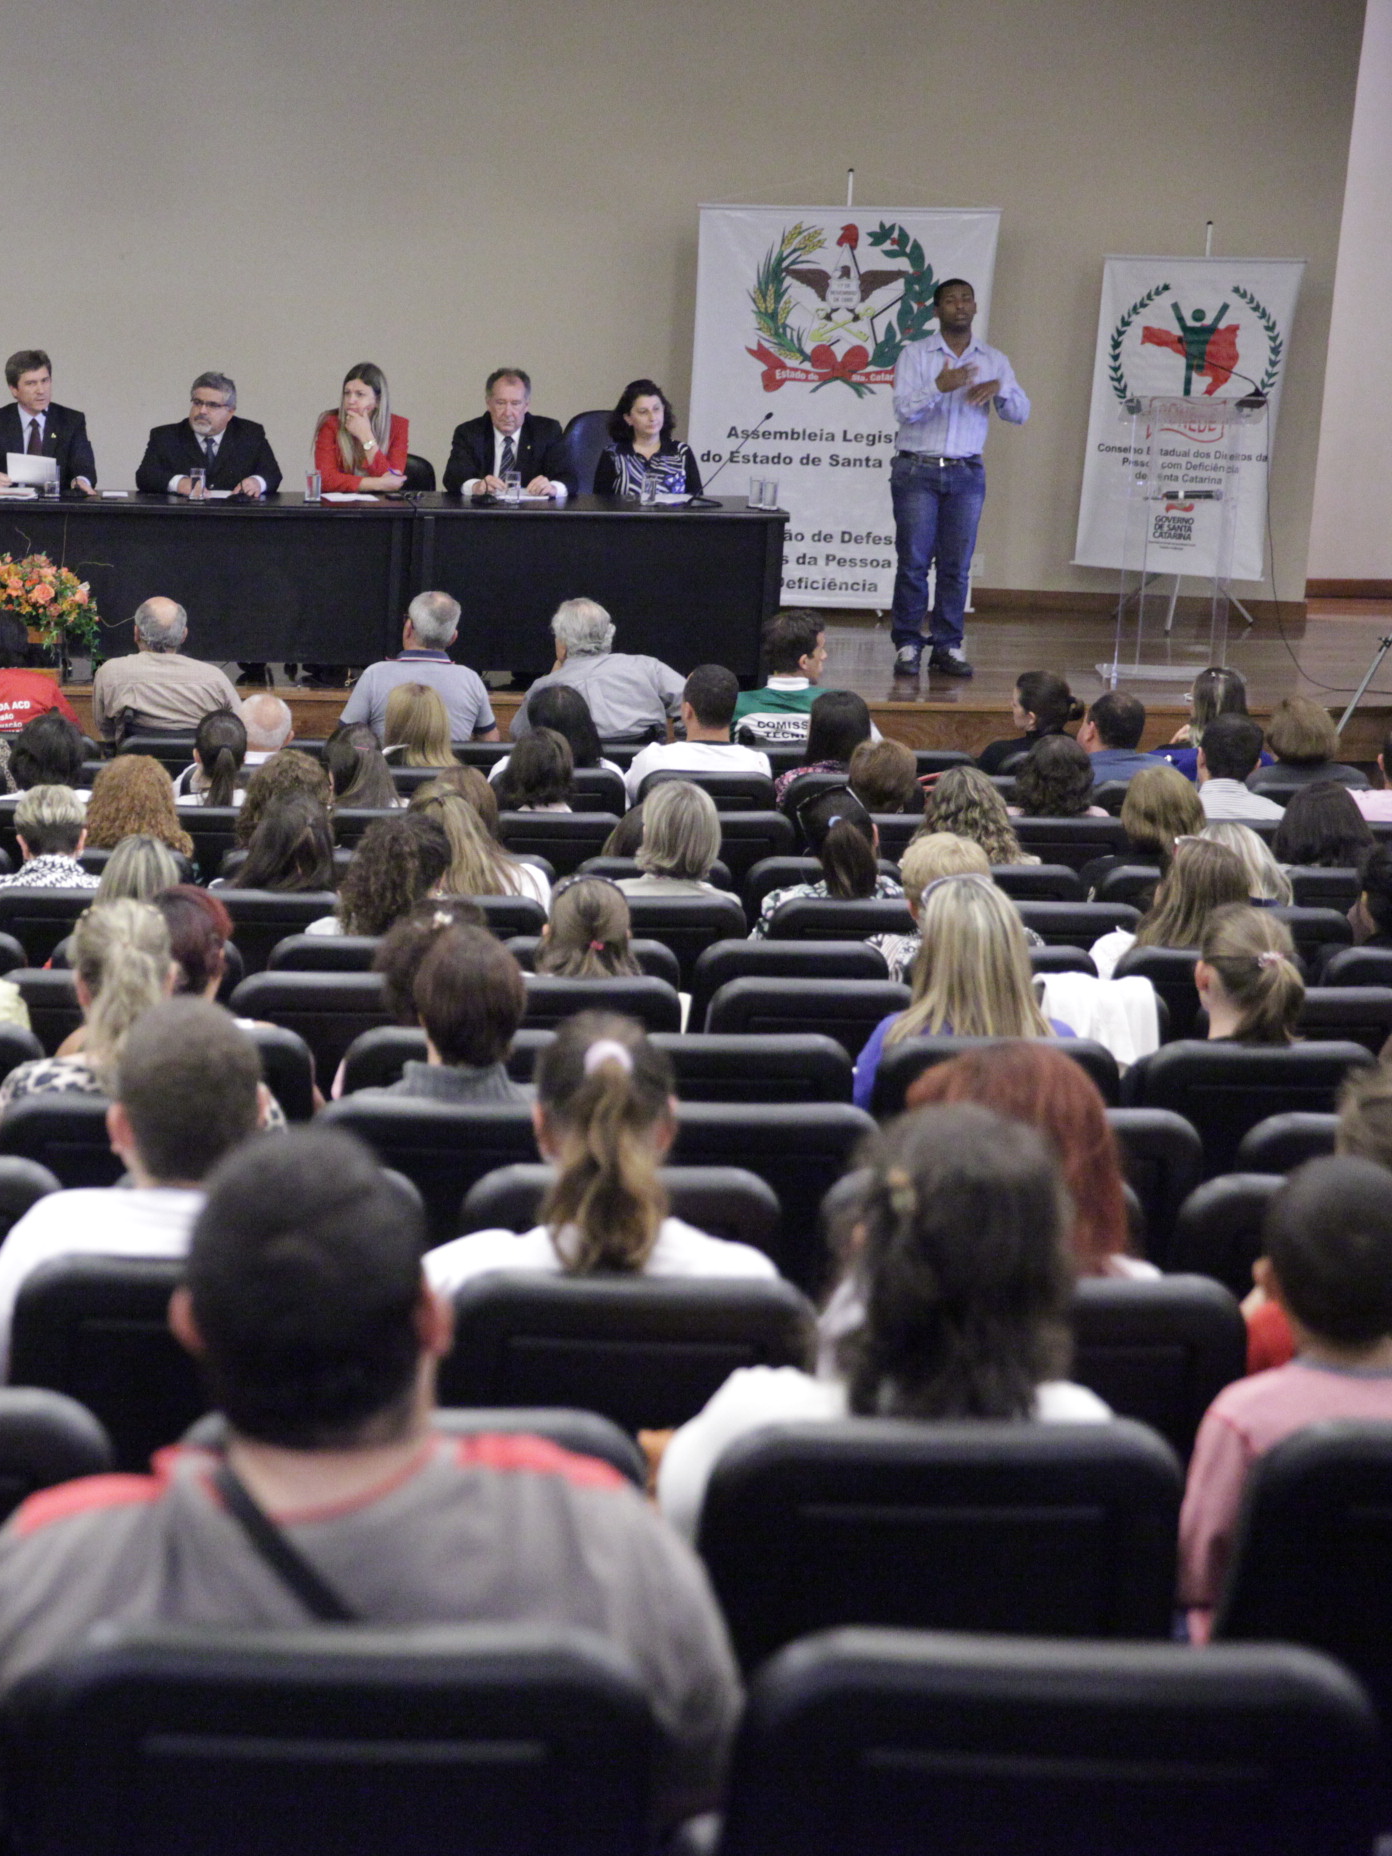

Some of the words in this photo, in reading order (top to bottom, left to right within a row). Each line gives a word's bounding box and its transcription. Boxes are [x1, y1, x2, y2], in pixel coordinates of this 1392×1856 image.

[775, 368, 807, 381] Estado
[808, 373, 820, 381] de
[727, 425, 836, 443] Assembleia
[700, 450, 723, 463] do
[729, 450, 793, 466] Estado
[799, 453, 822, 467] de
[828, 454, 883, 469] Santa
[1193, 450, 1211, 459] dos
[1161, 462, 1182, 470] com
[1134, 472, 1148, 480] de
[1182, 474, 1223, 485] Catarina
[1154, 515, 1194, 525] GOVERNO
[1166, 524, 1193, 533] SANTA
[811, 530, 834, 543] de
[840, 531, 896, 546] Defes
[1152, 530, 1192, 541] CATARINA
[796, 553, 818, 566] da
[825, 554, 892, 568] Pessoa
[781, 577, 878, 592] eficiência
